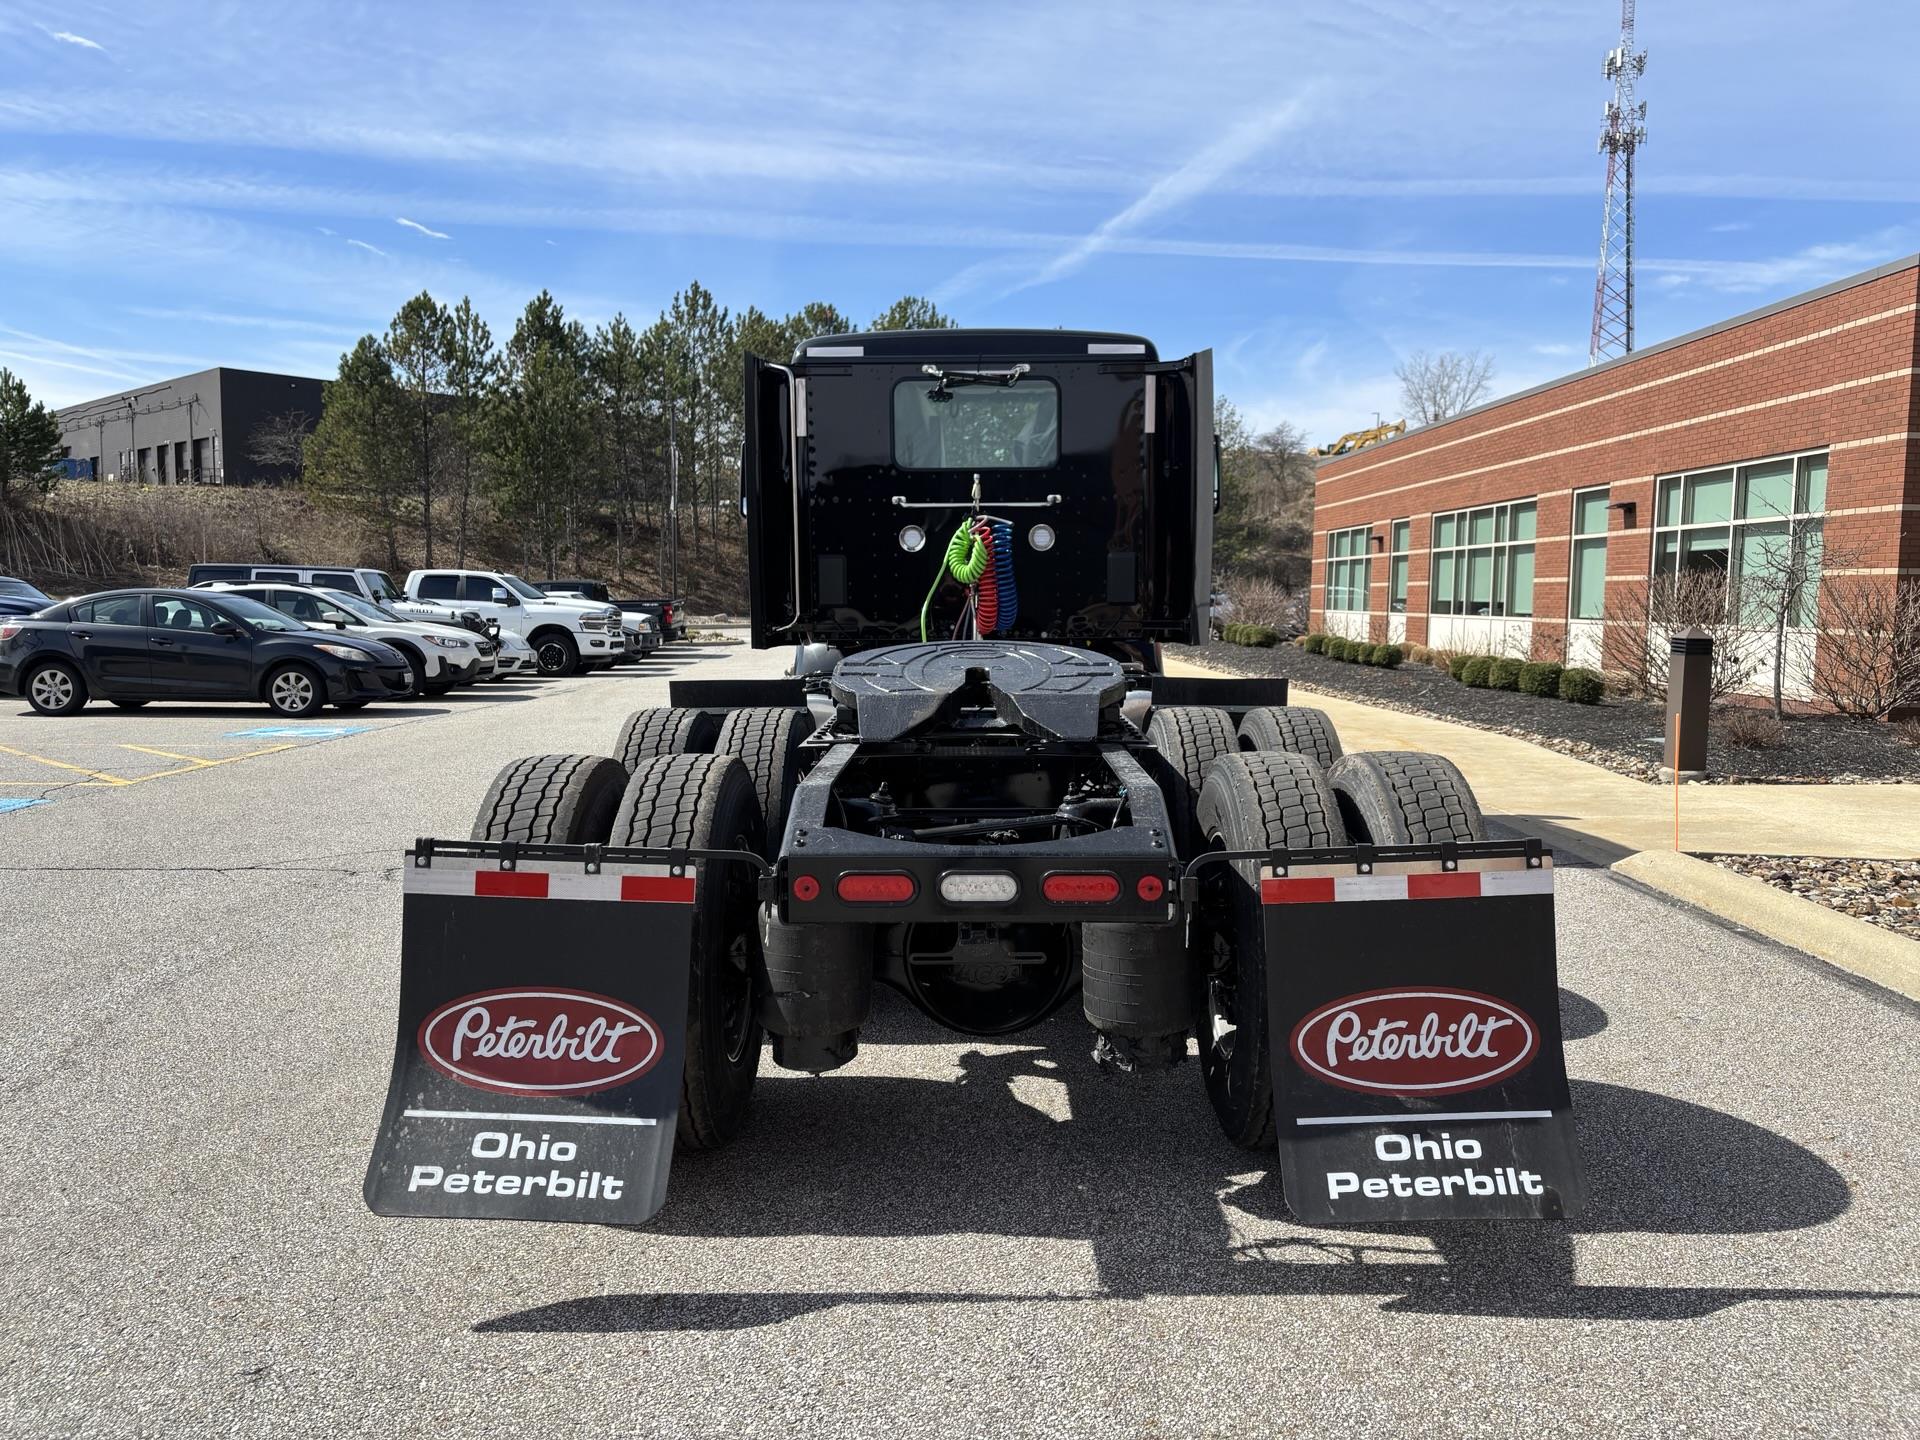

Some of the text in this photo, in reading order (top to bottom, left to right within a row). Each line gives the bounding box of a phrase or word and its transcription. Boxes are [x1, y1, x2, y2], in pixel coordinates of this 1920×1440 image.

[451, 1006, 641, 1063] Peterbilt
[1326, 1010, 1514, 1068] Peterbilt
[471, 1131, 578, 1162] Ohio
[1374, 1133, 1483, 1162] Ohio
[407, 1165, 624, 1200] Peterbilt
[1326, 1167, 1544, 1200] Peterbilt
